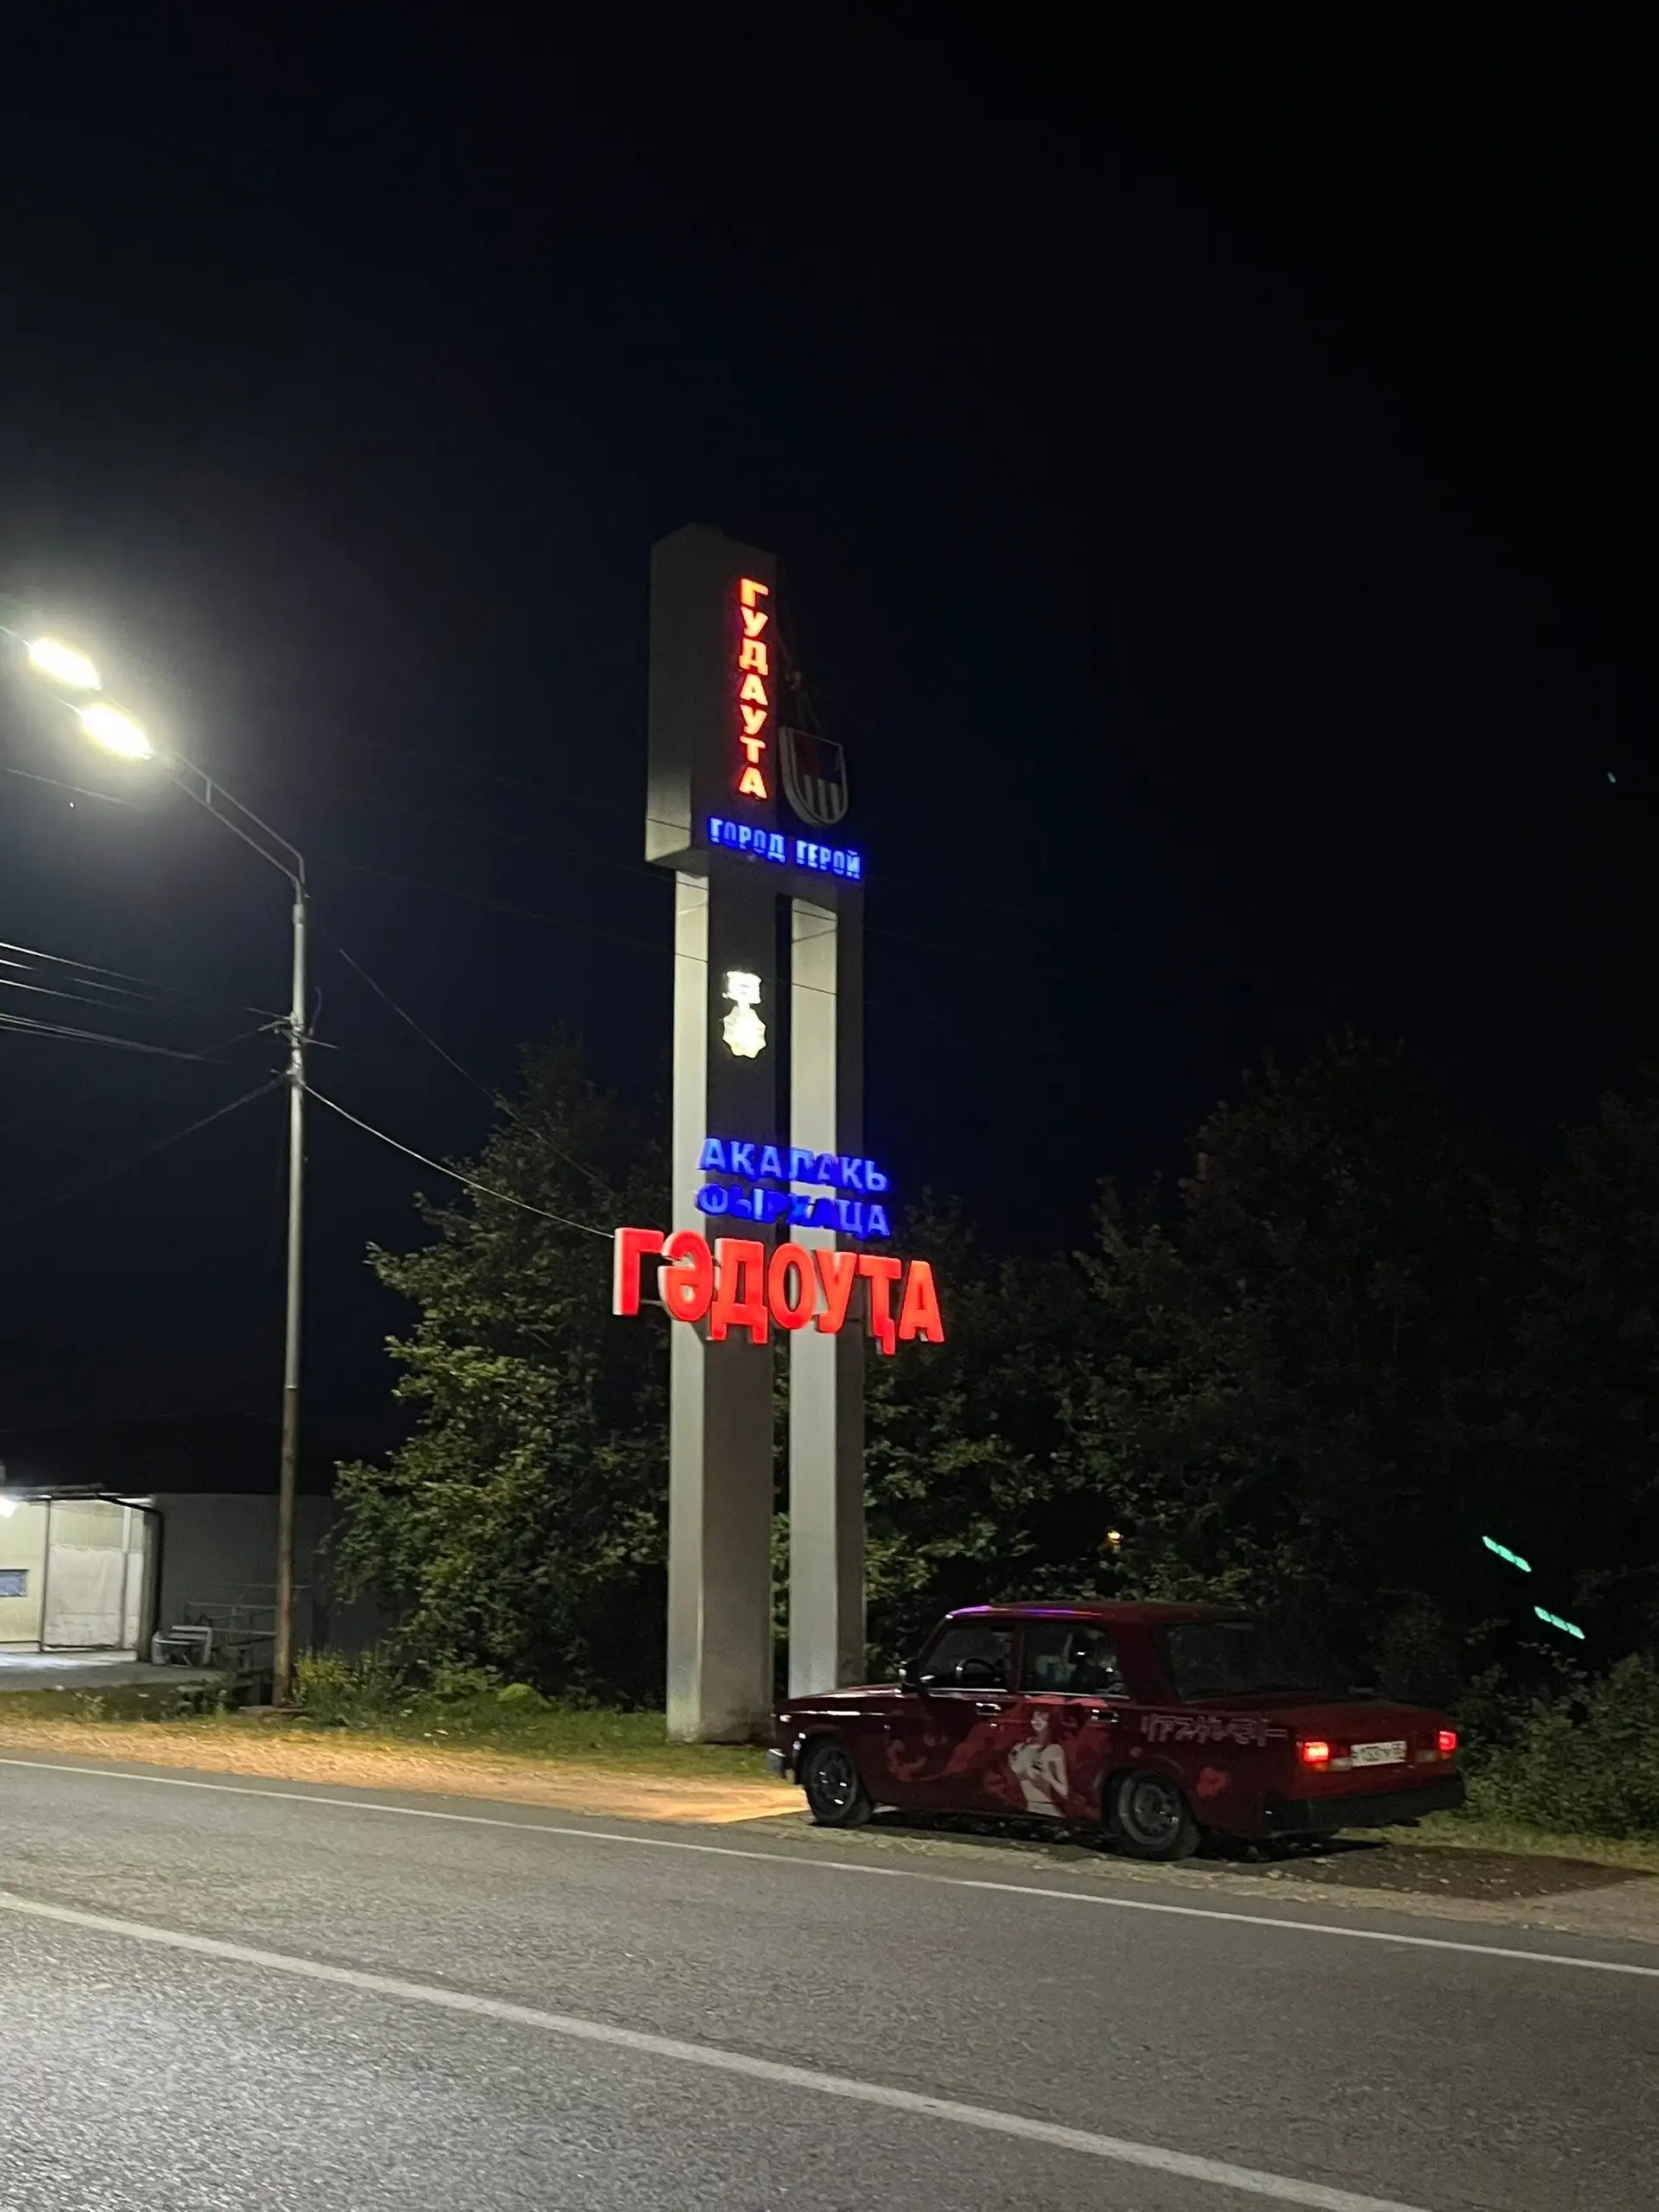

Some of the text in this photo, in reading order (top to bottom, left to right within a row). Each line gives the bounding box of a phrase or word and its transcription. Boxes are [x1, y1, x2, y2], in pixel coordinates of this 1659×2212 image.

[739, 577, 769, 799] ГУДАУТА
[709, 817, 861, 880] ГОРОД ГЕРОЙ
